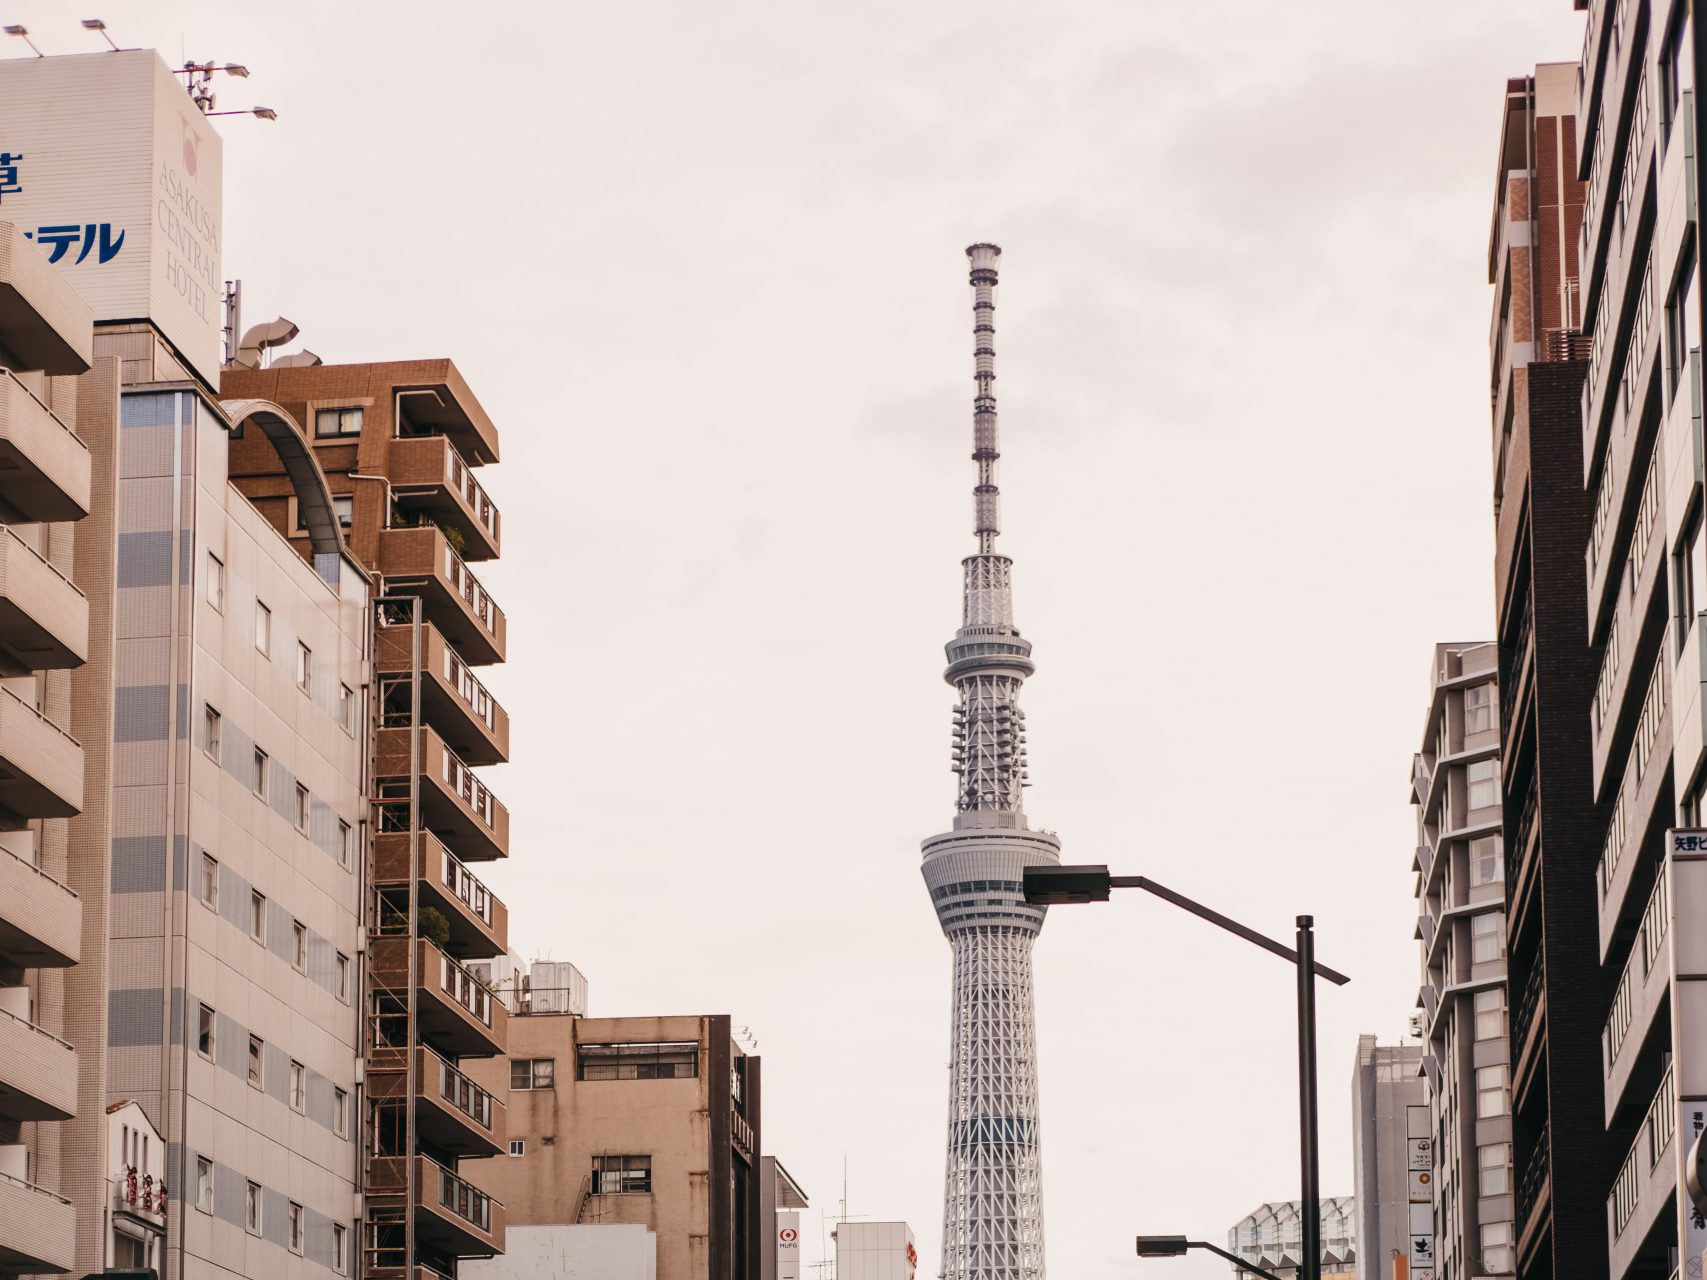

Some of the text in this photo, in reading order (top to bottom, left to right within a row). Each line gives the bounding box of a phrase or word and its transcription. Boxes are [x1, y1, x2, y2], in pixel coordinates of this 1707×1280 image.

[25, 223, 125, 265] テル
[157, 200, 218, 295] CENTRAL
[159, 160, 218, 253] ASAKUSA
[166, 252, 210, 326] HOTEL
